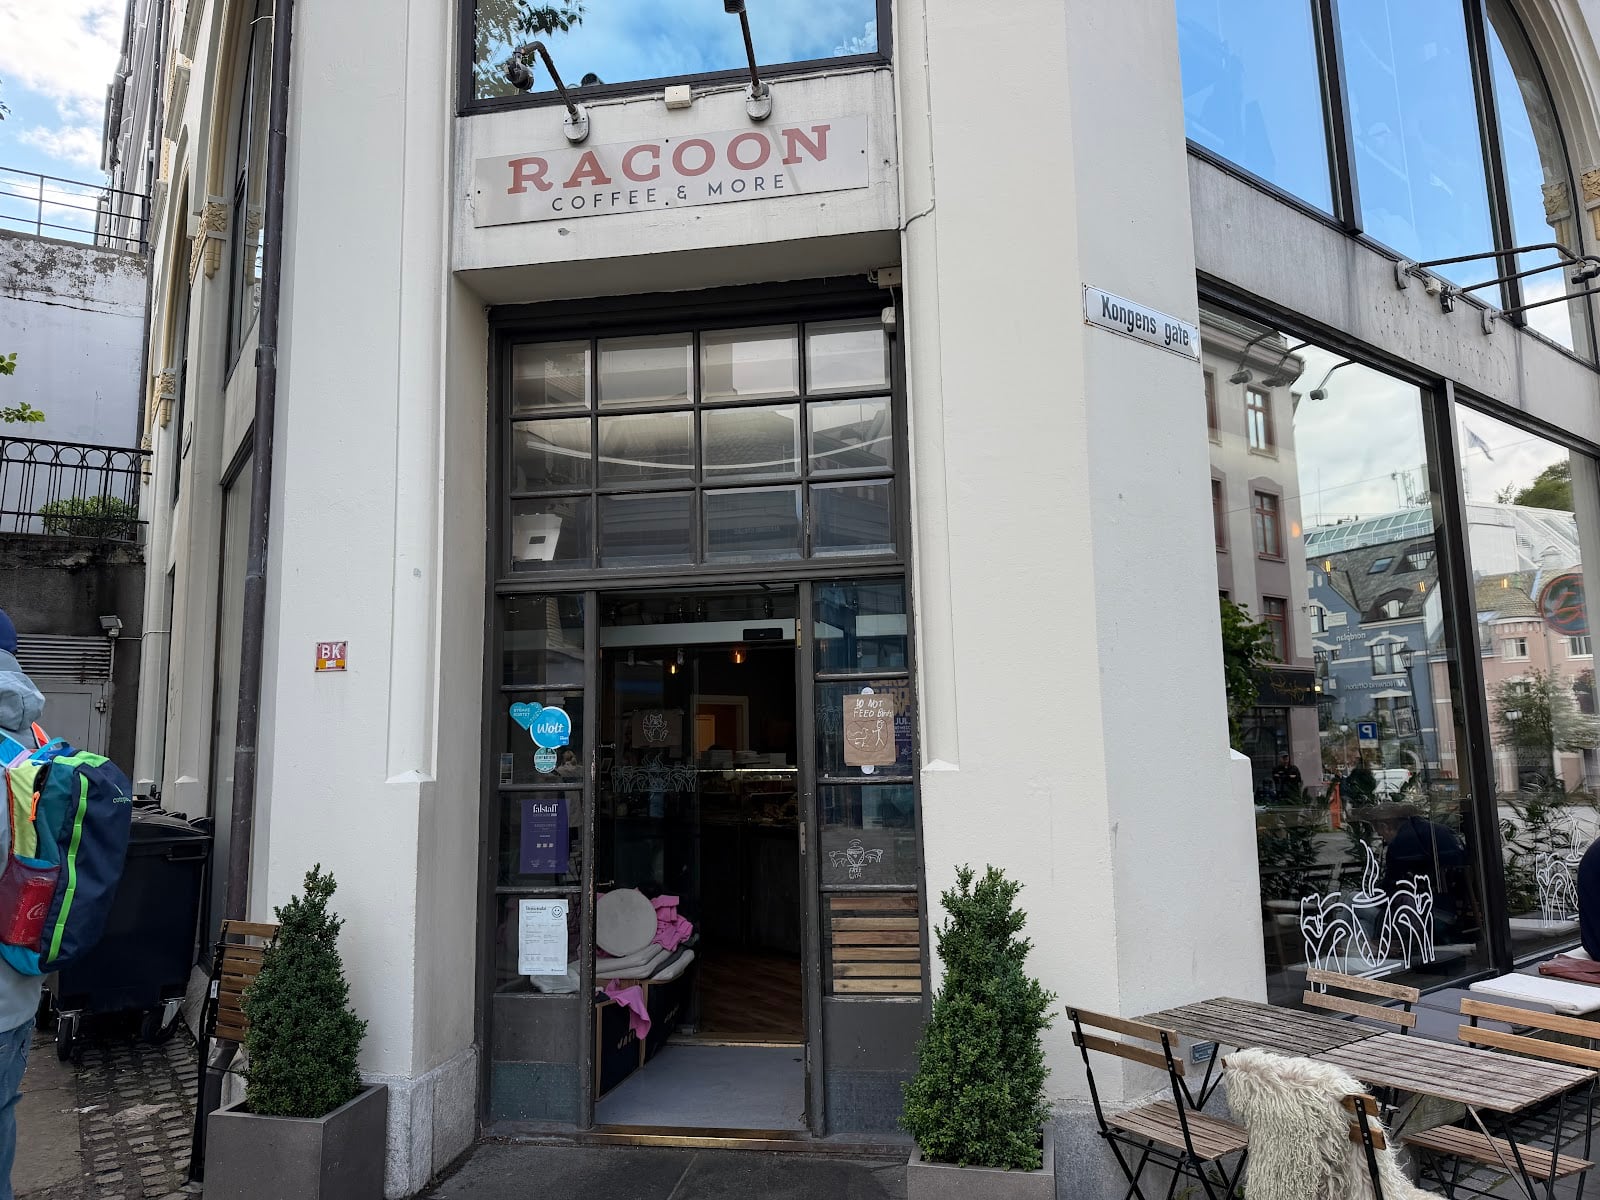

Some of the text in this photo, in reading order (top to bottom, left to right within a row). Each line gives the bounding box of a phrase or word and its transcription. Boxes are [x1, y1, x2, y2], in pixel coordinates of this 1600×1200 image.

[507, 124, 831, 194] RACOON
[551, 173, 785, 212] COFFEE & MORE
[1101, 295, 1189, 346] Kongens gate
[322, 644, 341, 658] BK
[868, 699, 883, 708] NOT
[854, 708, 874, 718] FEED
[537, 722, 564, 734] Wolt
[533, 804, 559, 813] falstaff
